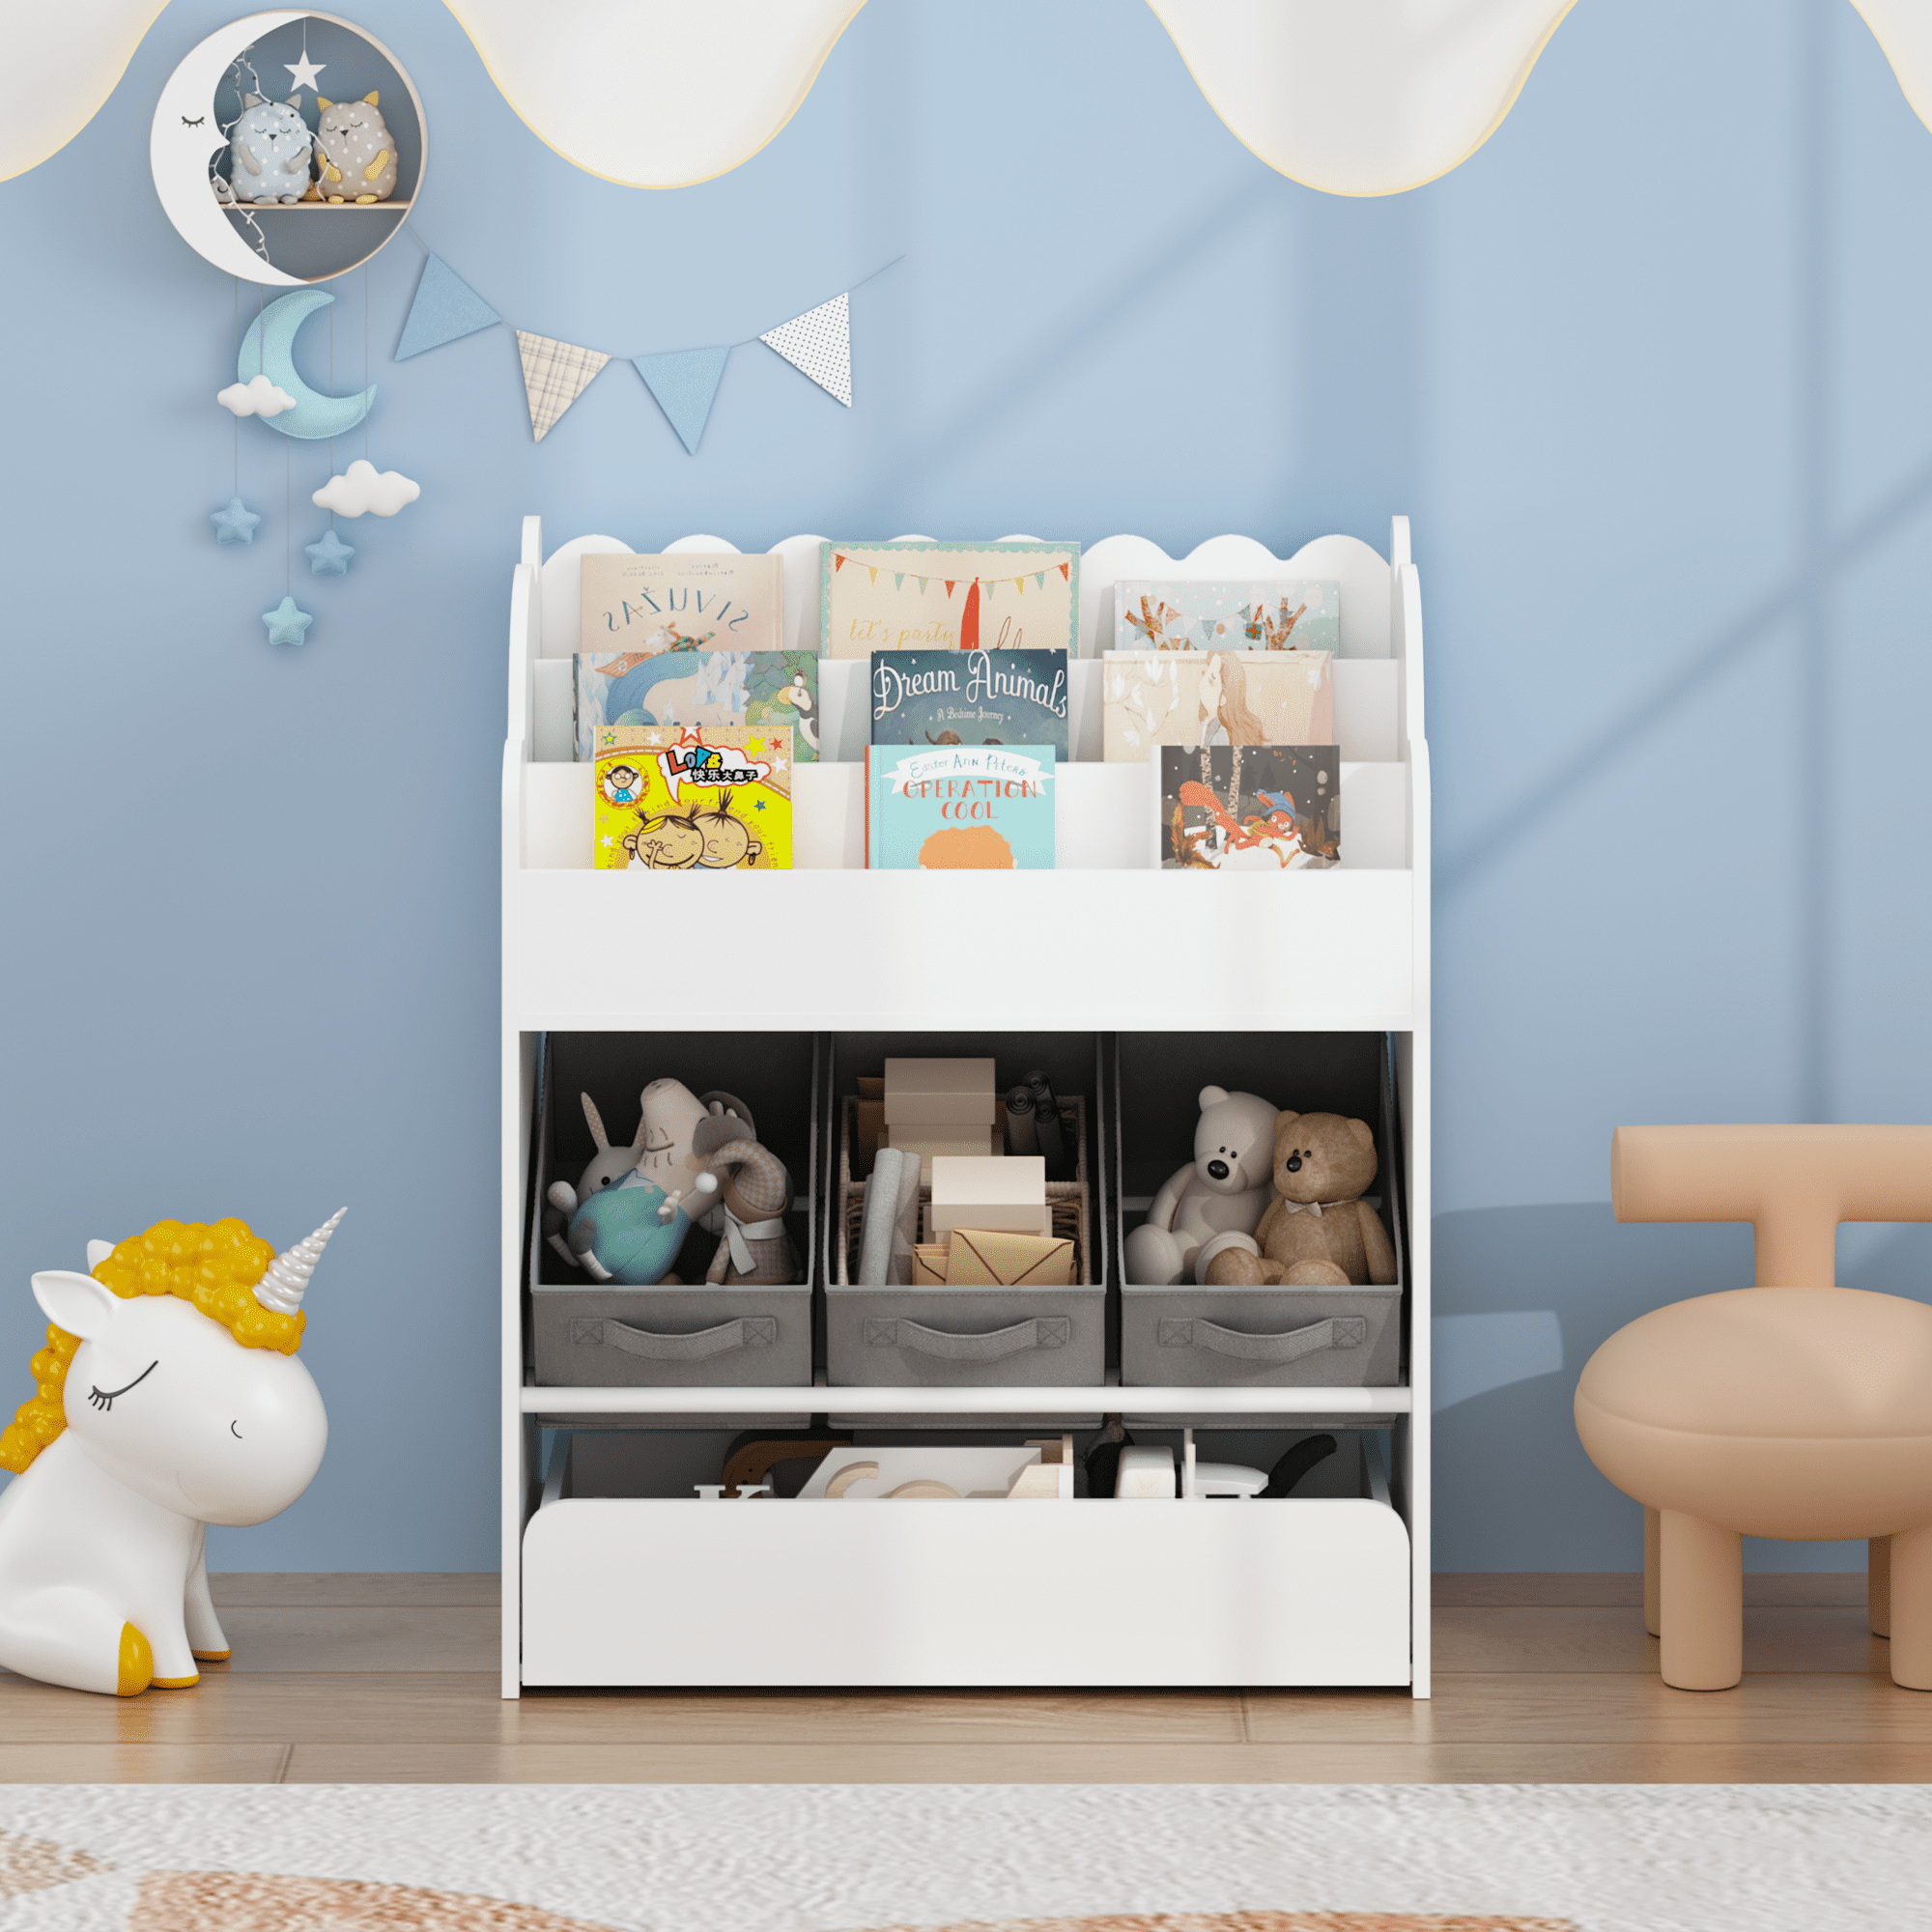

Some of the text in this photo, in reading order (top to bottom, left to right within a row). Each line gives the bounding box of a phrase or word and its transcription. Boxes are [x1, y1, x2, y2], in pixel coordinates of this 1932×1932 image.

[873, 649, 1067, 721] Dream Animals
[692, 769, 758, 781] 快乐大鼻子
[902, 779, 1037, 799] OPERATION
[941, 801, 999, 820] COOL
